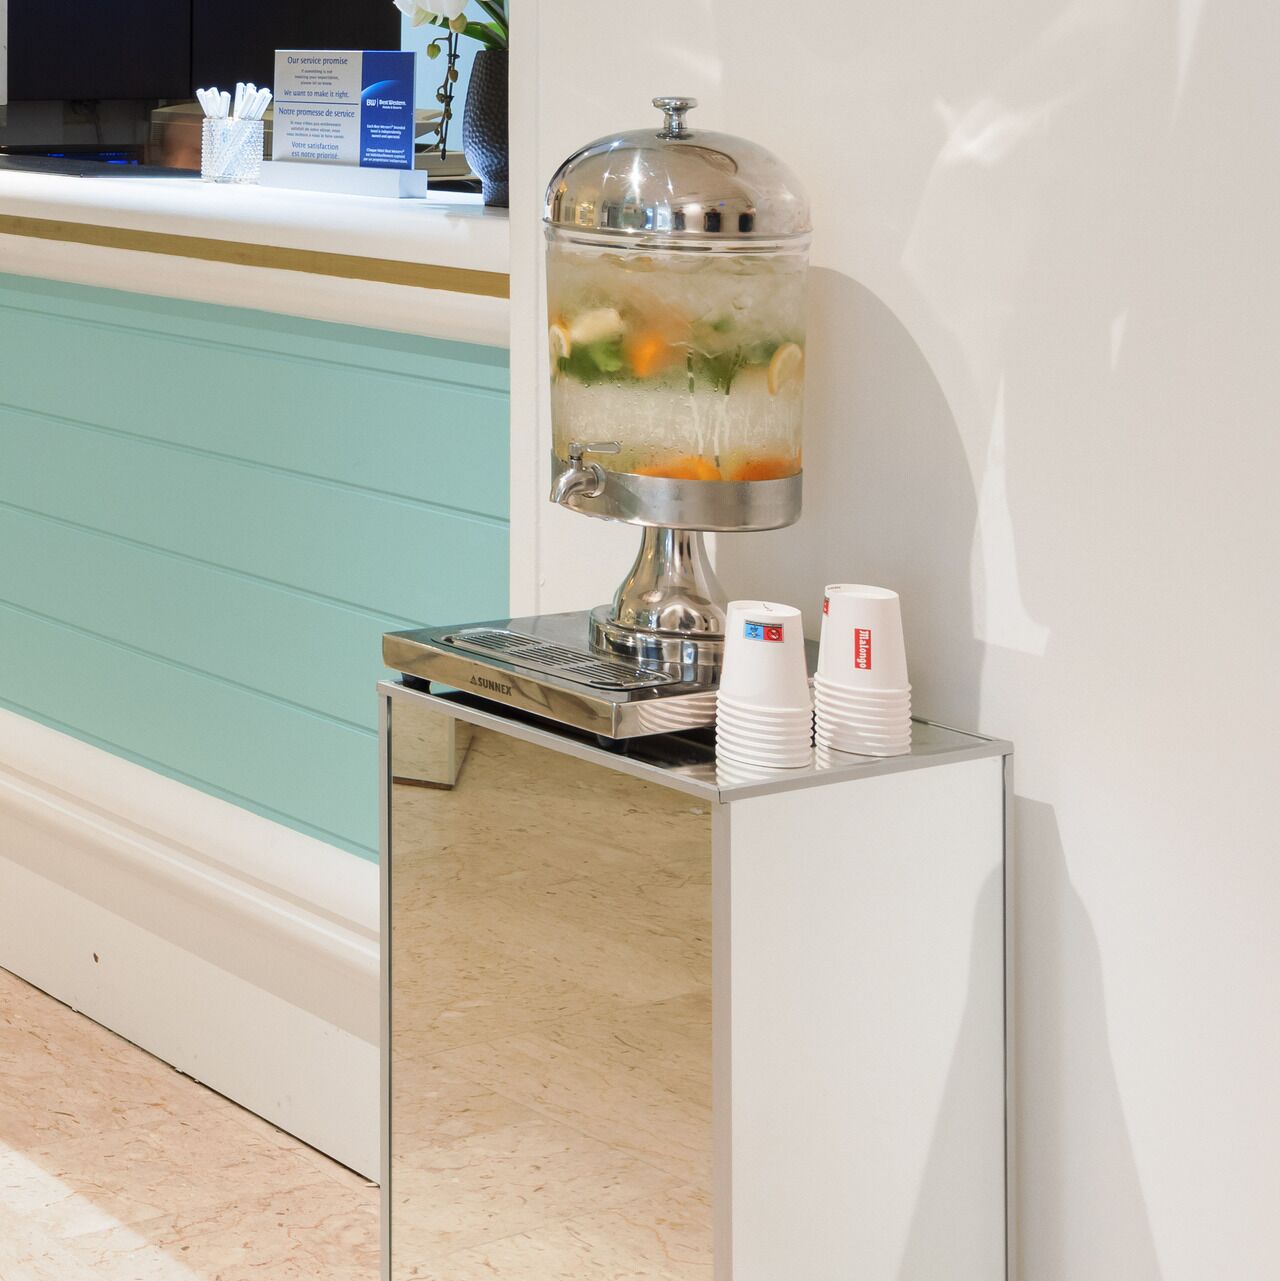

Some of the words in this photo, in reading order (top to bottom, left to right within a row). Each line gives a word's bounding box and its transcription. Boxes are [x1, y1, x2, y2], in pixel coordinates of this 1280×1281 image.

[287, 56, 299, 64] Our
[300, 57, 321, 65] service
[322, 57, 348, 65] promise
[314, 90, 329, 98] make
[278, 107, 296, 115] Notre
[296, 108, 325, 117] promesse
[325, 109, 333, 117] de
[334, 110, 355, 118] service
[291, 141, 307, 149] Votre
[307, 142, 339, 150] satisfaction
[858, 629, 870, 670] Malongo
[477, 676, 513, 697] SUNNEX
